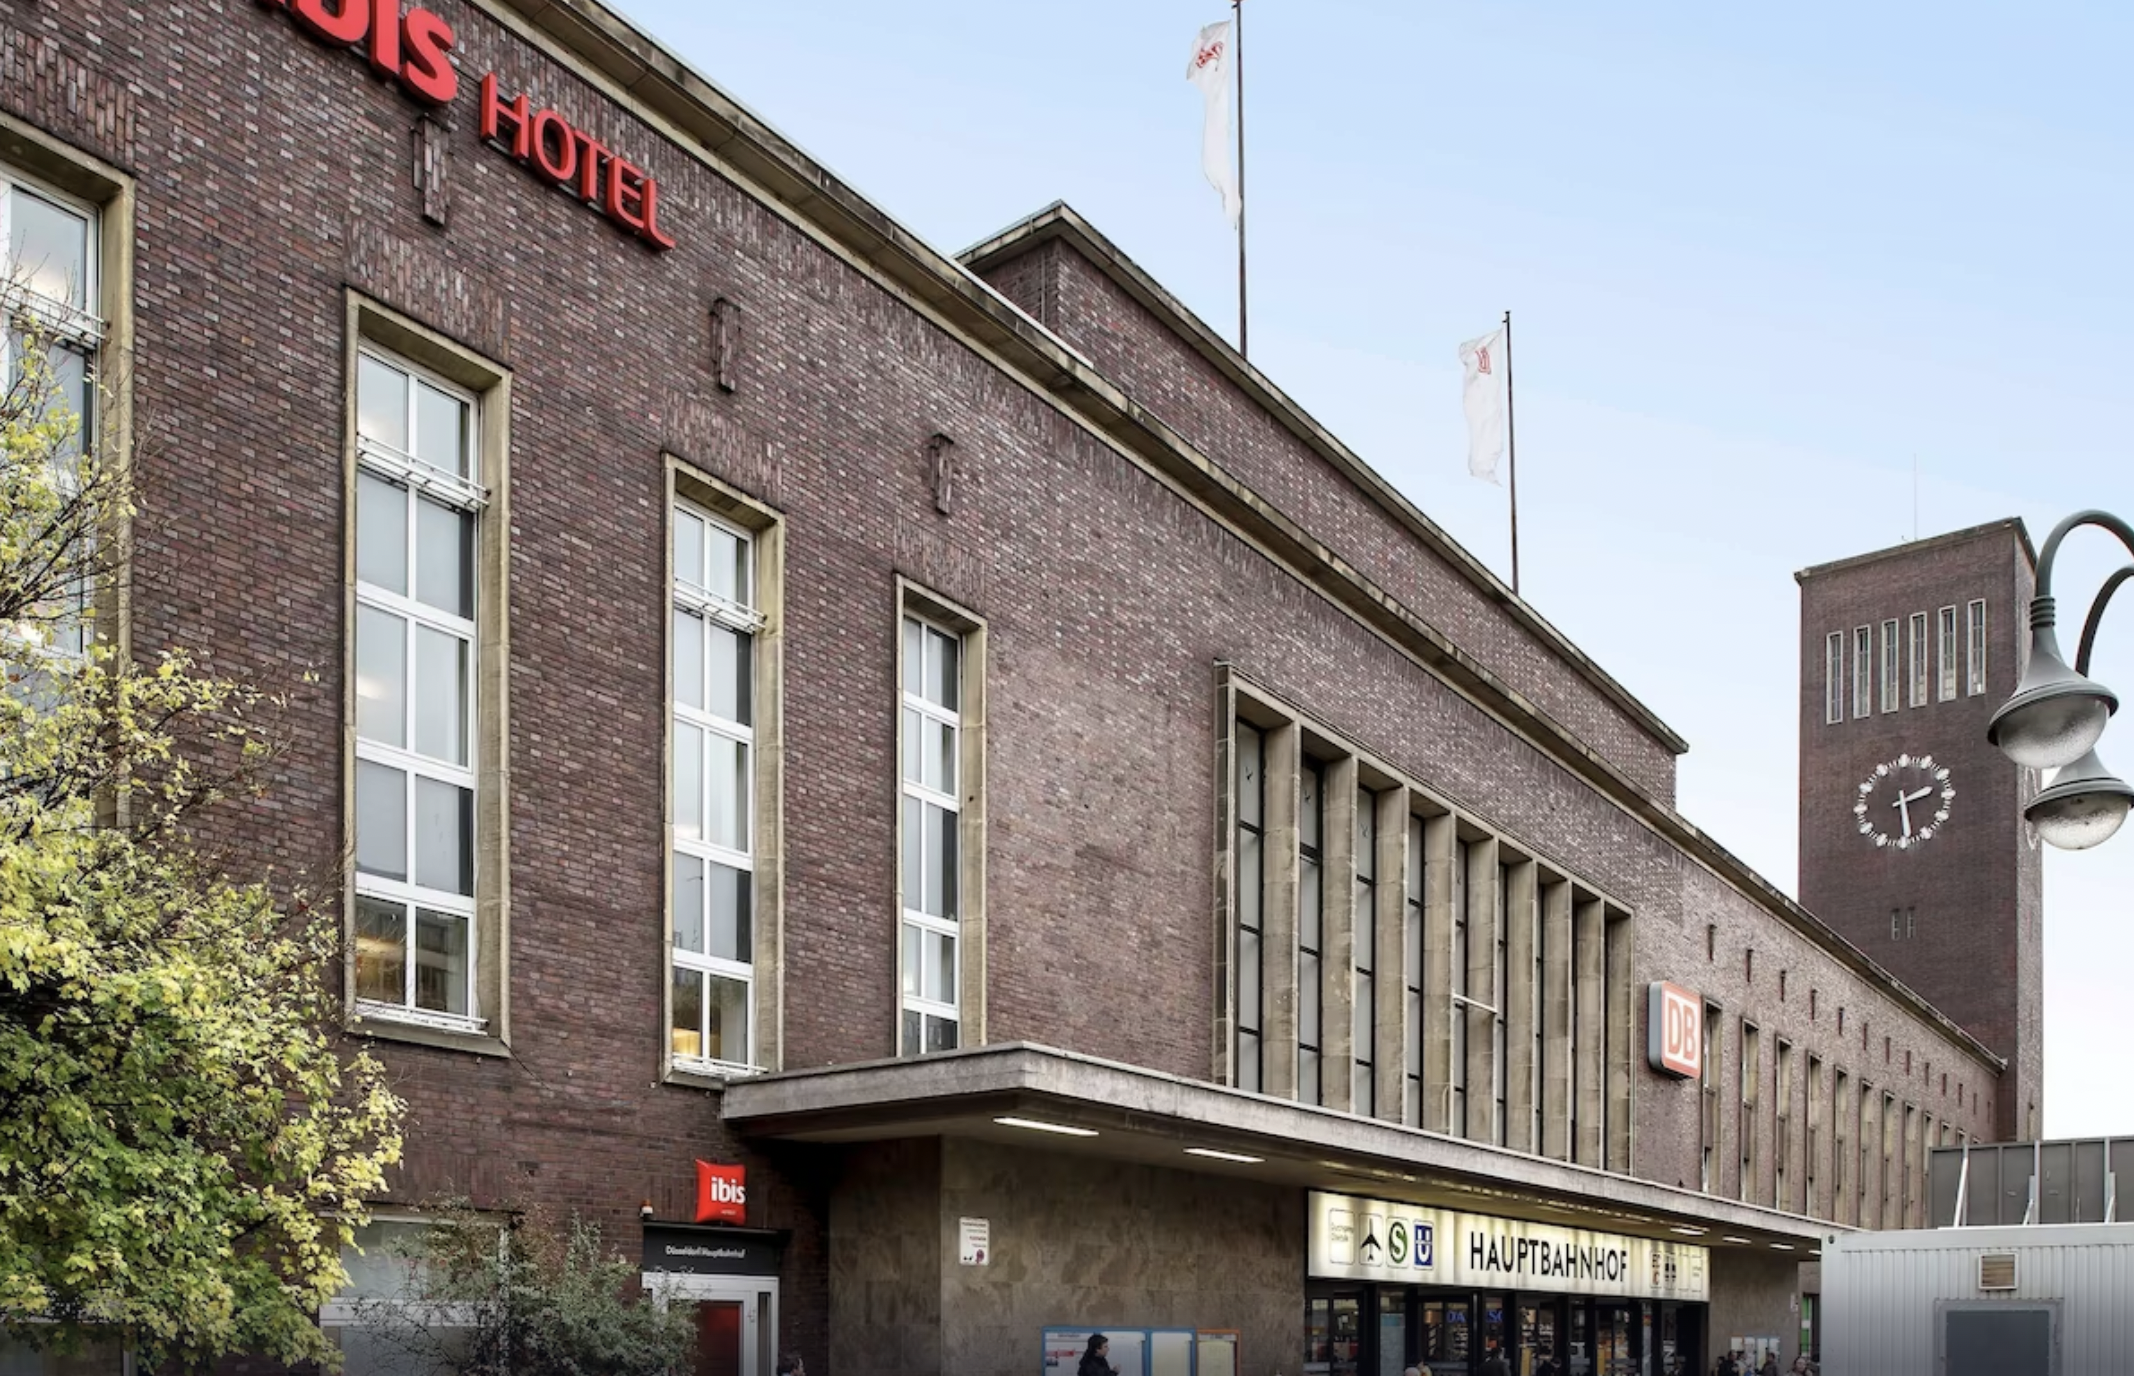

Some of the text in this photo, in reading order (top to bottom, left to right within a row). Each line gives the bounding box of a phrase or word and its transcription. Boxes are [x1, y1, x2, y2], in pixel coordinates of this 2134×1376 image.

[480, 72, 676, 251] HOTEL
[1667, 998, 1697, 1061] DB
[711, 1176, 746, 1204] ibis
[1471, 1231, 1627, 1282] HAUPTBAHNHOF
